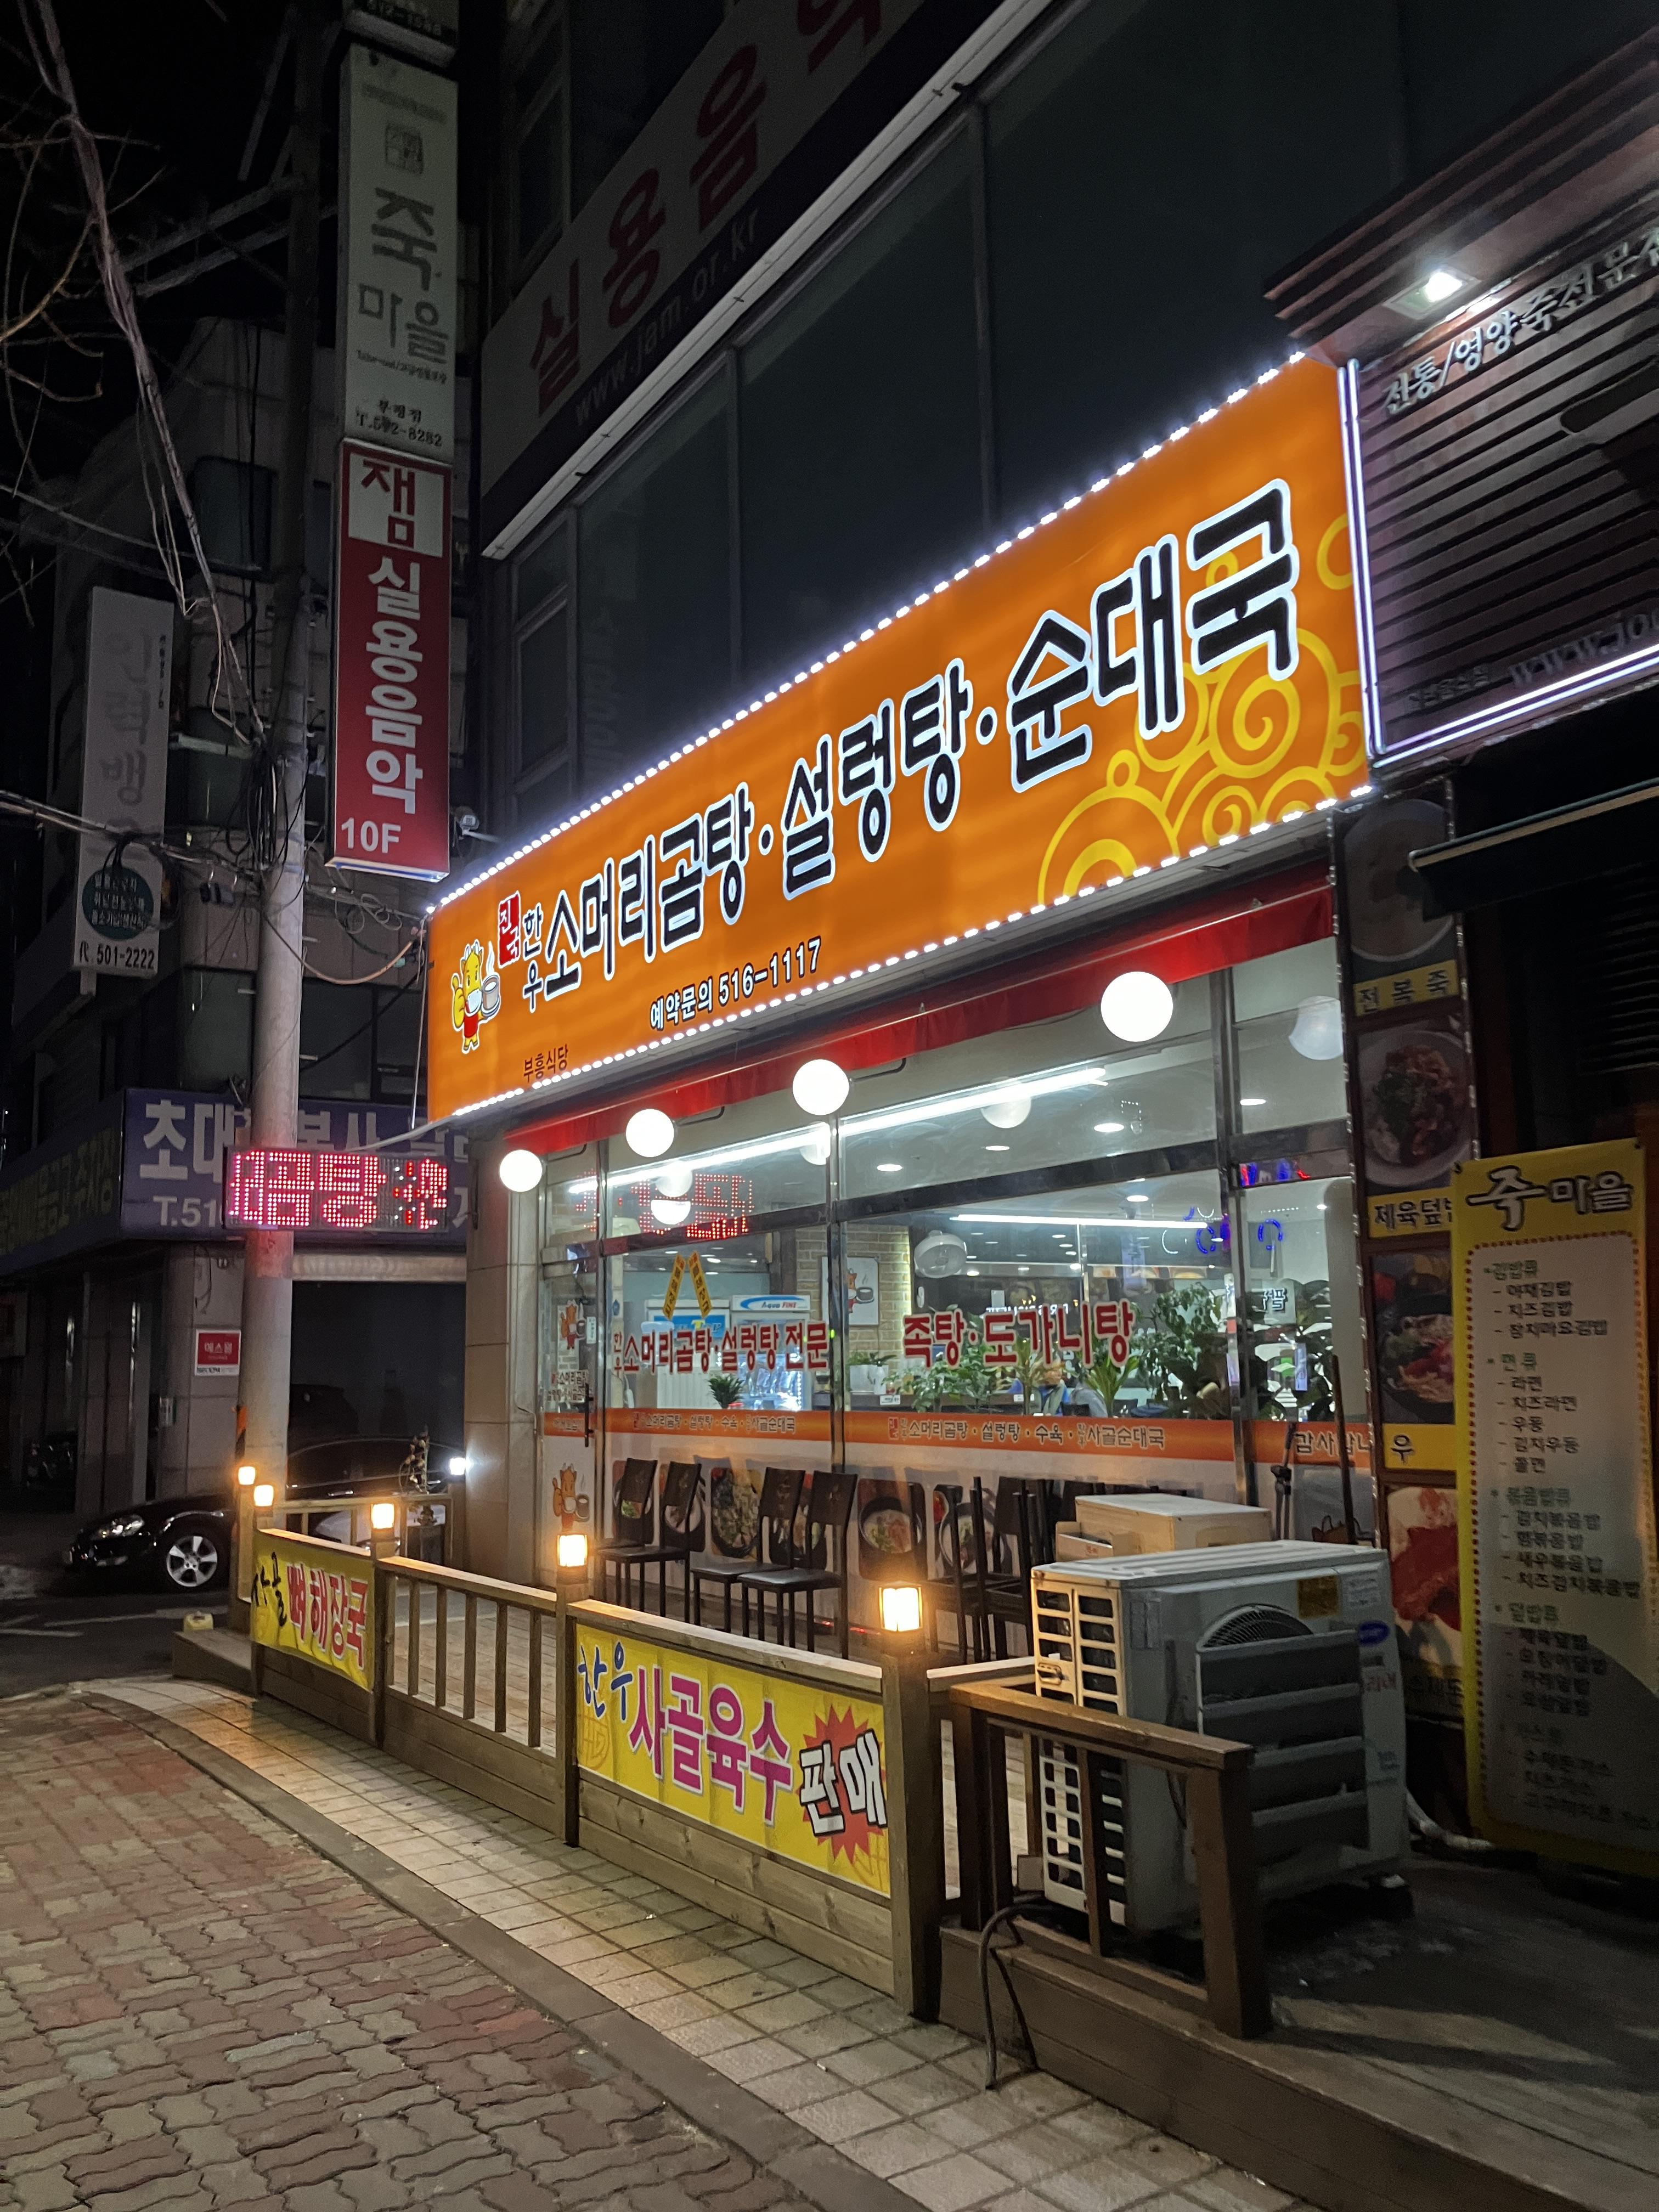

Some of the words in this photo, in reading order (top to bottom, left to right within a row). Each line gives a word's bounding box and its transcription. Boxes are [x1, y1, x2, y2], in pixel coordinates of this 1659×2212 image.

[576, 208, 760, 429] www.jam.or.kr
[359, 459, 415, 549] 잼
[365, 555, 425, 815] 실용음악
[340, 816, 402, 854] 10F
[97, 944, 155, 969] 501-2222
[650, 978, 713, 1031] 예약문의
[718, 935, 823, 1006] 516-1117
[523, 1043, 569, 1083] 부흥식당
[785, 1321, 828, 1370] 전문
[909, 1419, 968, 1440] 소머리곰탕
[982, 1421, 1020, 1442] 설렁탕
[1036, 1425, 1063, 1445] 수육
[1088, 1424, 1165, 1449] 사골순대국
[577, 1641, 634, 1722] 한우
[628, 1664, 793, 1827] 사골육수
[799, 1728, 888, 1837] 판매
